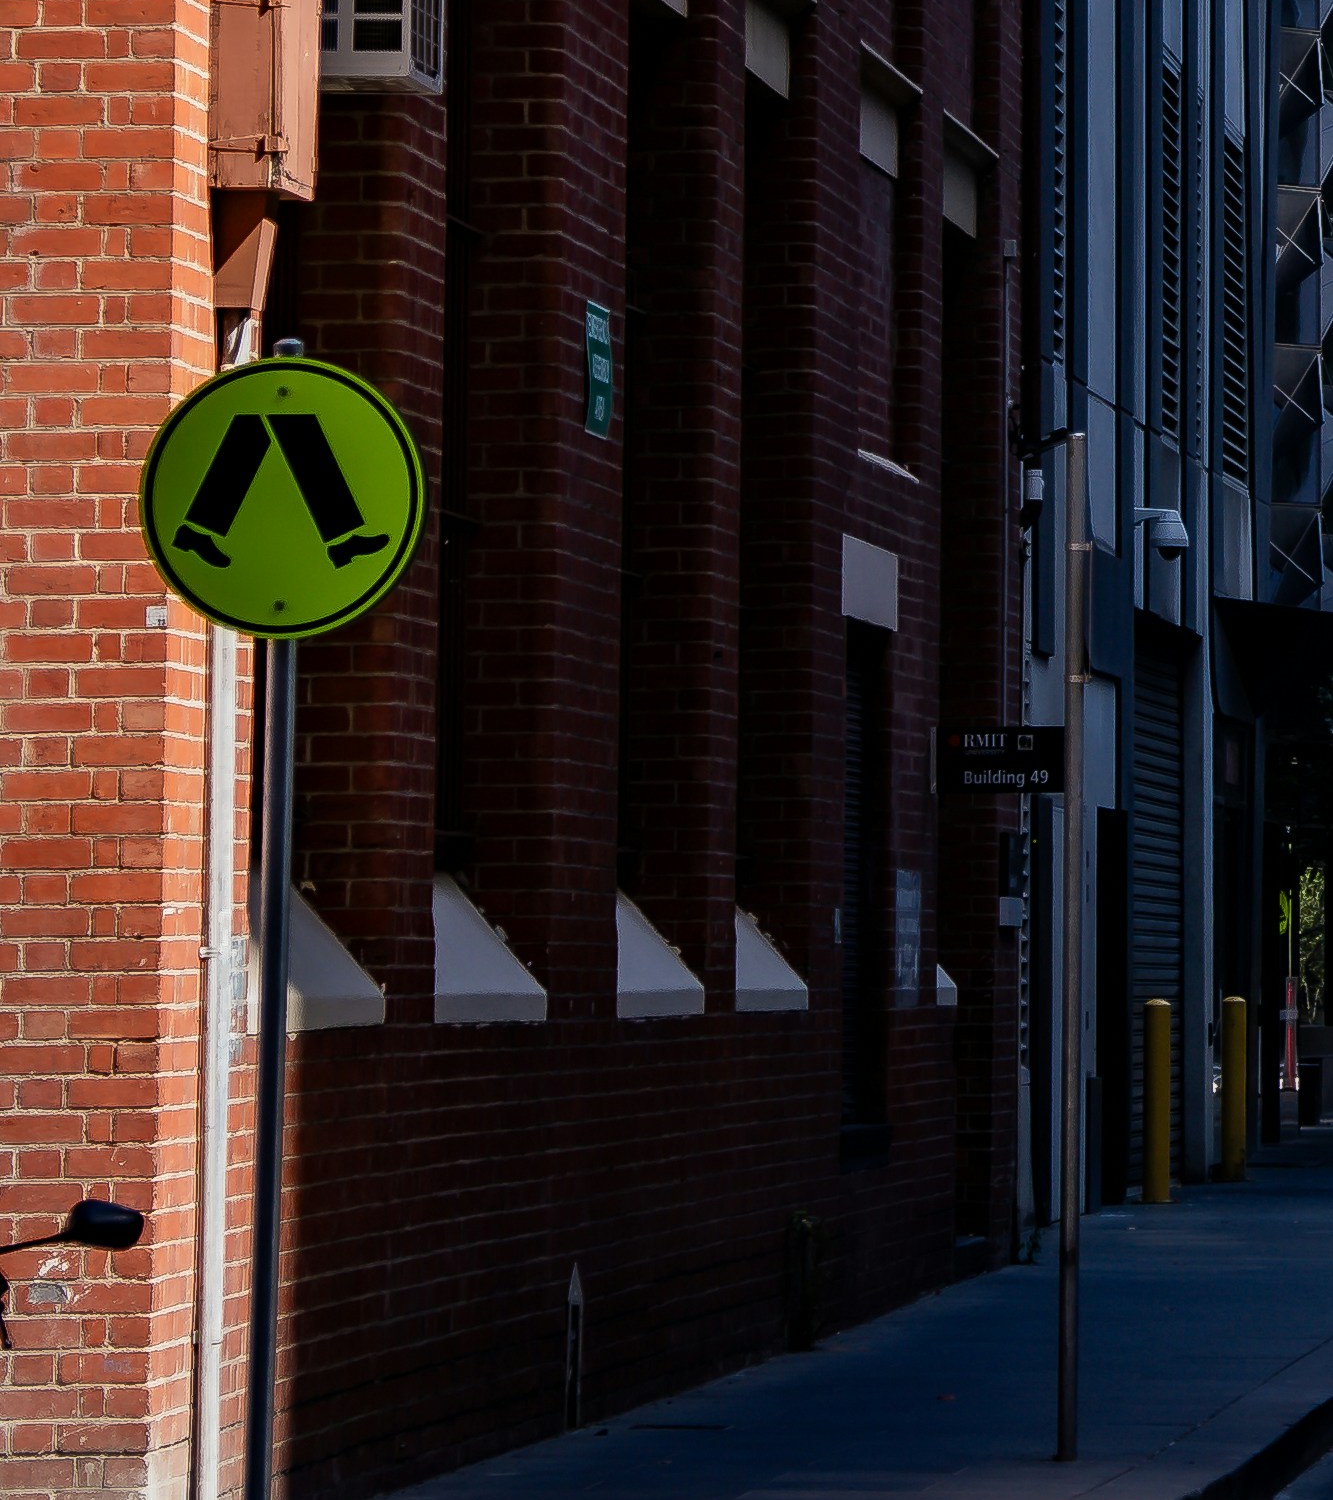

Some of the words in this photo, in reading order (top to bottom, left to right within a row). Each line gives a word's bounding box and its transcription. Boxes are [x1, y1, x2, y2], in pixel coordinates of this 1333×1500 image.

[963, 733, 1008, 747] RMIT
[963, 769, 1026, 788] Building
[1030, 769, 1049, 784] 49
